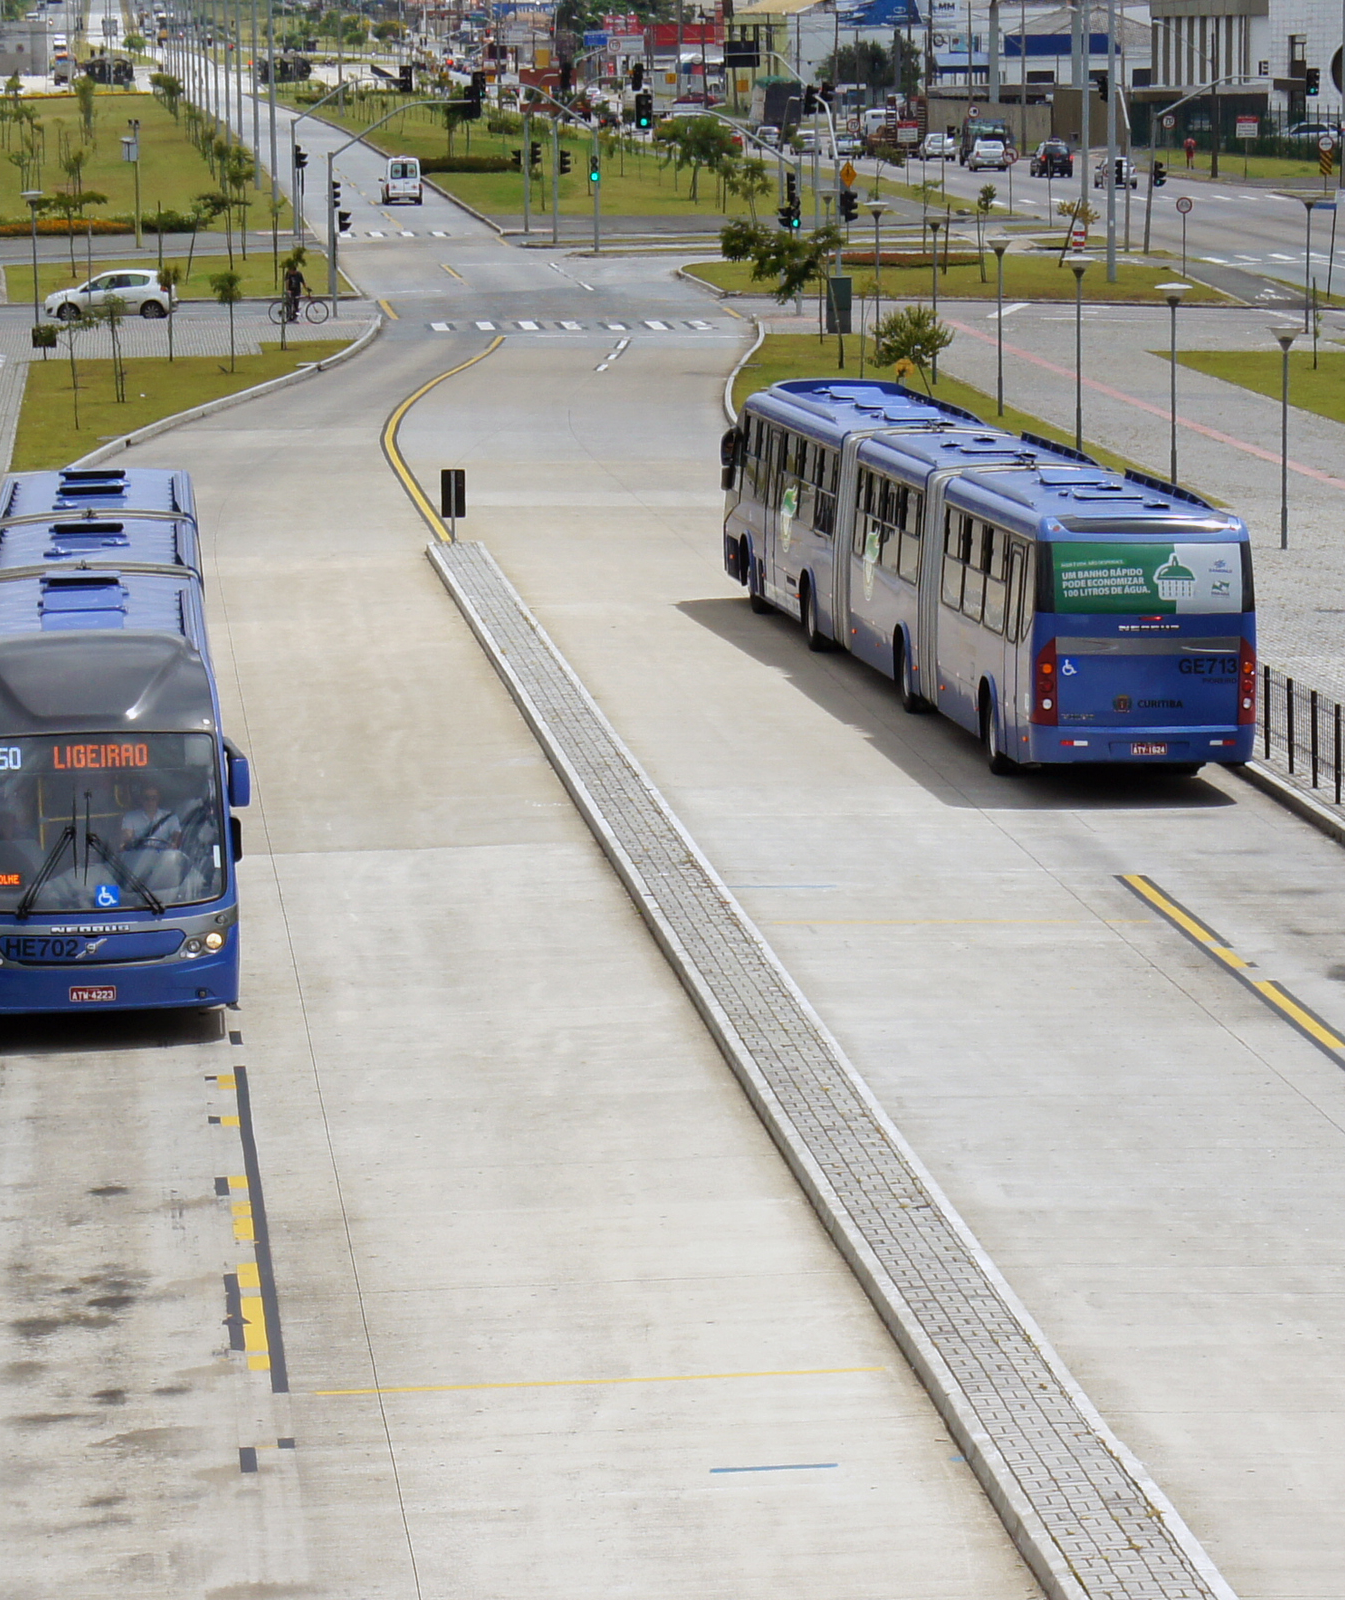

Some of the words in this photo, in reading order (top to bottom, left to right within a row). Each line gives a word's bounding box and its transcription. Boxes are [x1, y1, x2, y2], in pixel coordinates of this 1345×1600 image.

[1062, 571, 1076, 580] UM
[1077, 569, 1109, 579] BANHO
[1110, 567, 1143, 577] RÁPIDO
[1062, 580, 1086, 589] PODE
[1087, 576, 1145, 587] ECONOMIZAR
[1063, 589, 1079, 598] 100
[1080, 587, 1110, 597] LITROS
[1111, 586, 1123, 595] DE
[1124, 584, 1151, 594] ÁGUA.
[1178, 658, 1238, 675] GE713
[1137, 699, 1183, 709] CURITIBA
[54, 743, 149, 769] LIGEIRAO
[5, 938, 79, 957] HE702
